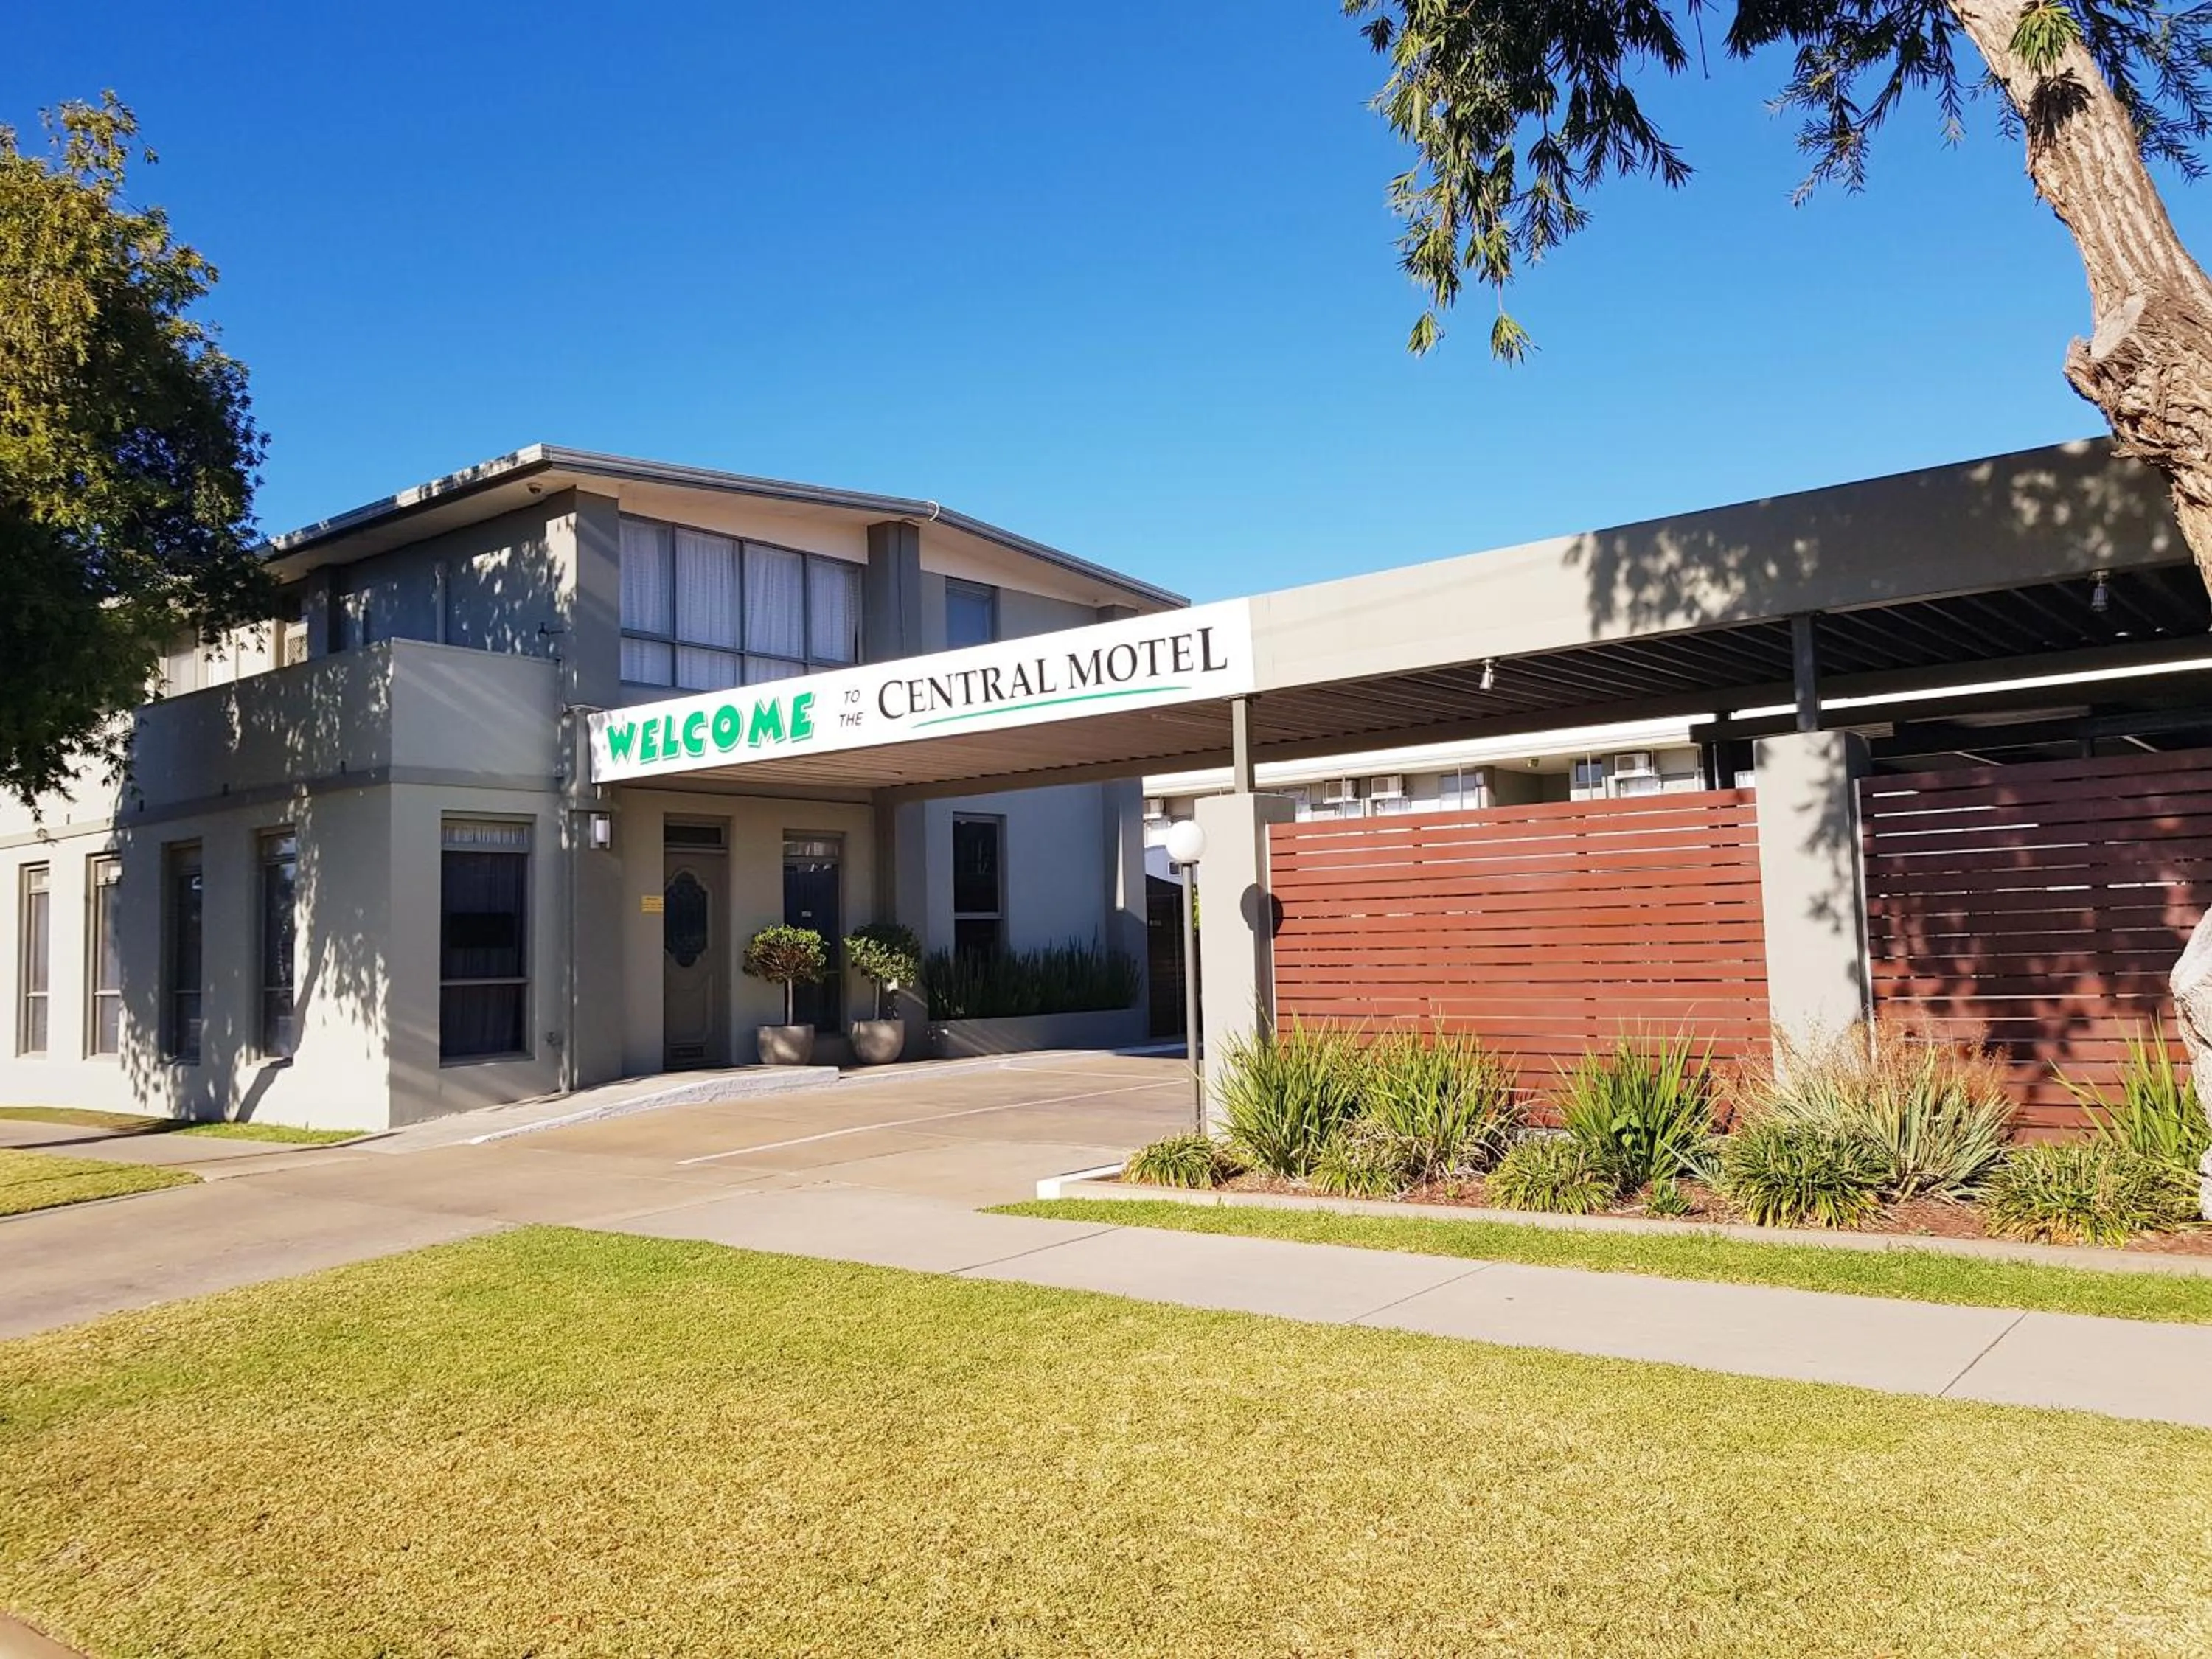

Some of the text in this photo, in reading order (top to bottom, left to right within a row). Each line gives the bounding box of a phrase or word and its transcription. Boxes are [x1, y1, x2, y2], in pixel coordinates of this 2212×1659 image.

[878, 627, 1228, 720] CENTRAL MOTEL
[844, 690, 860, 703] TO
[606, 692, 815, 764] WELCOME
[839, 712, 863, 727] THE
